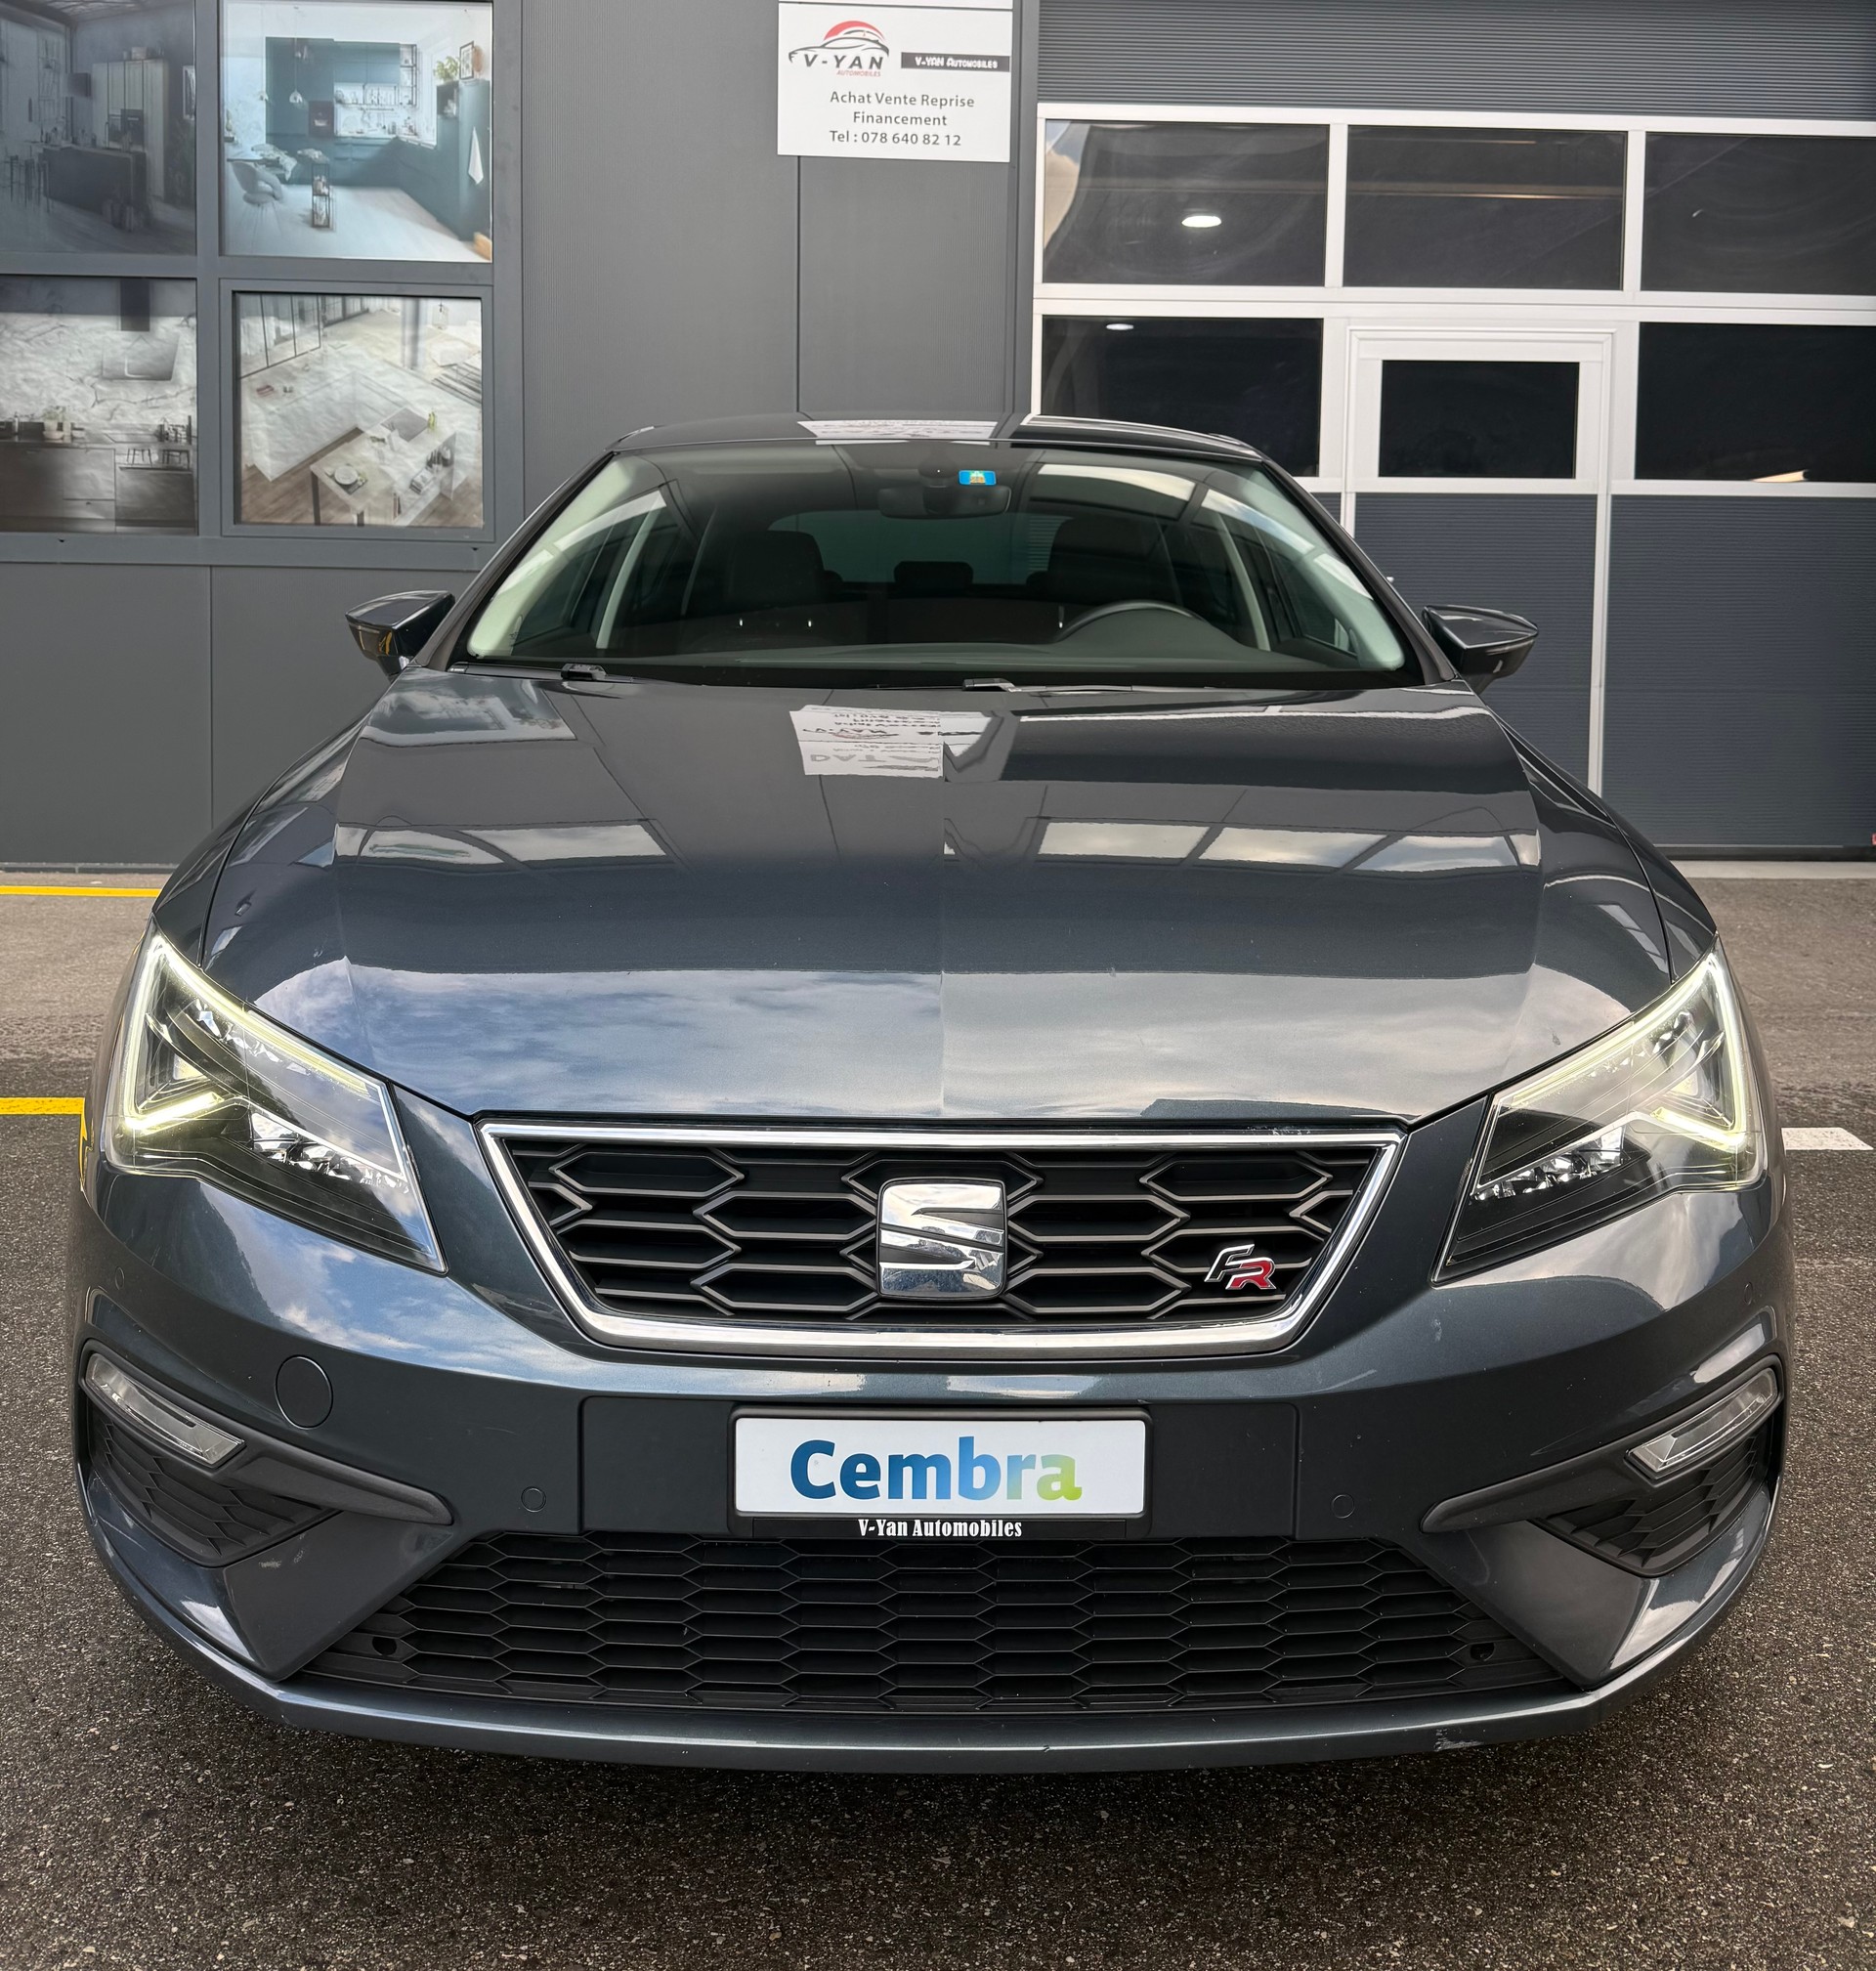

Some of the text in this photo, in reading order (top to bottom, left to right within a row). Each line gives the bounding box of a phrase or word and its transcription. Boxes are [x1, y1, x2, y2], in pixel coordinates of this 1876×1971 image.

[804, 54, 883, 69] V-YAN
[915, 57, 945, 66] V-YAN
[830, 91, 975, 109] Achat Vente Reprise
[853, 111, 948, 126] Financement
[861, 132, 888, 144] 078
[892, 133, 918, 145] 640
[922, 134, 940, 146] 82
[945, 134, 961, 146] 12
[1204, 1243, 1277, 1290] FR
[789, 1435, 1083, 1501] Cembra
[858, 1519, 1022, 1537] V-Yan Automobiles
